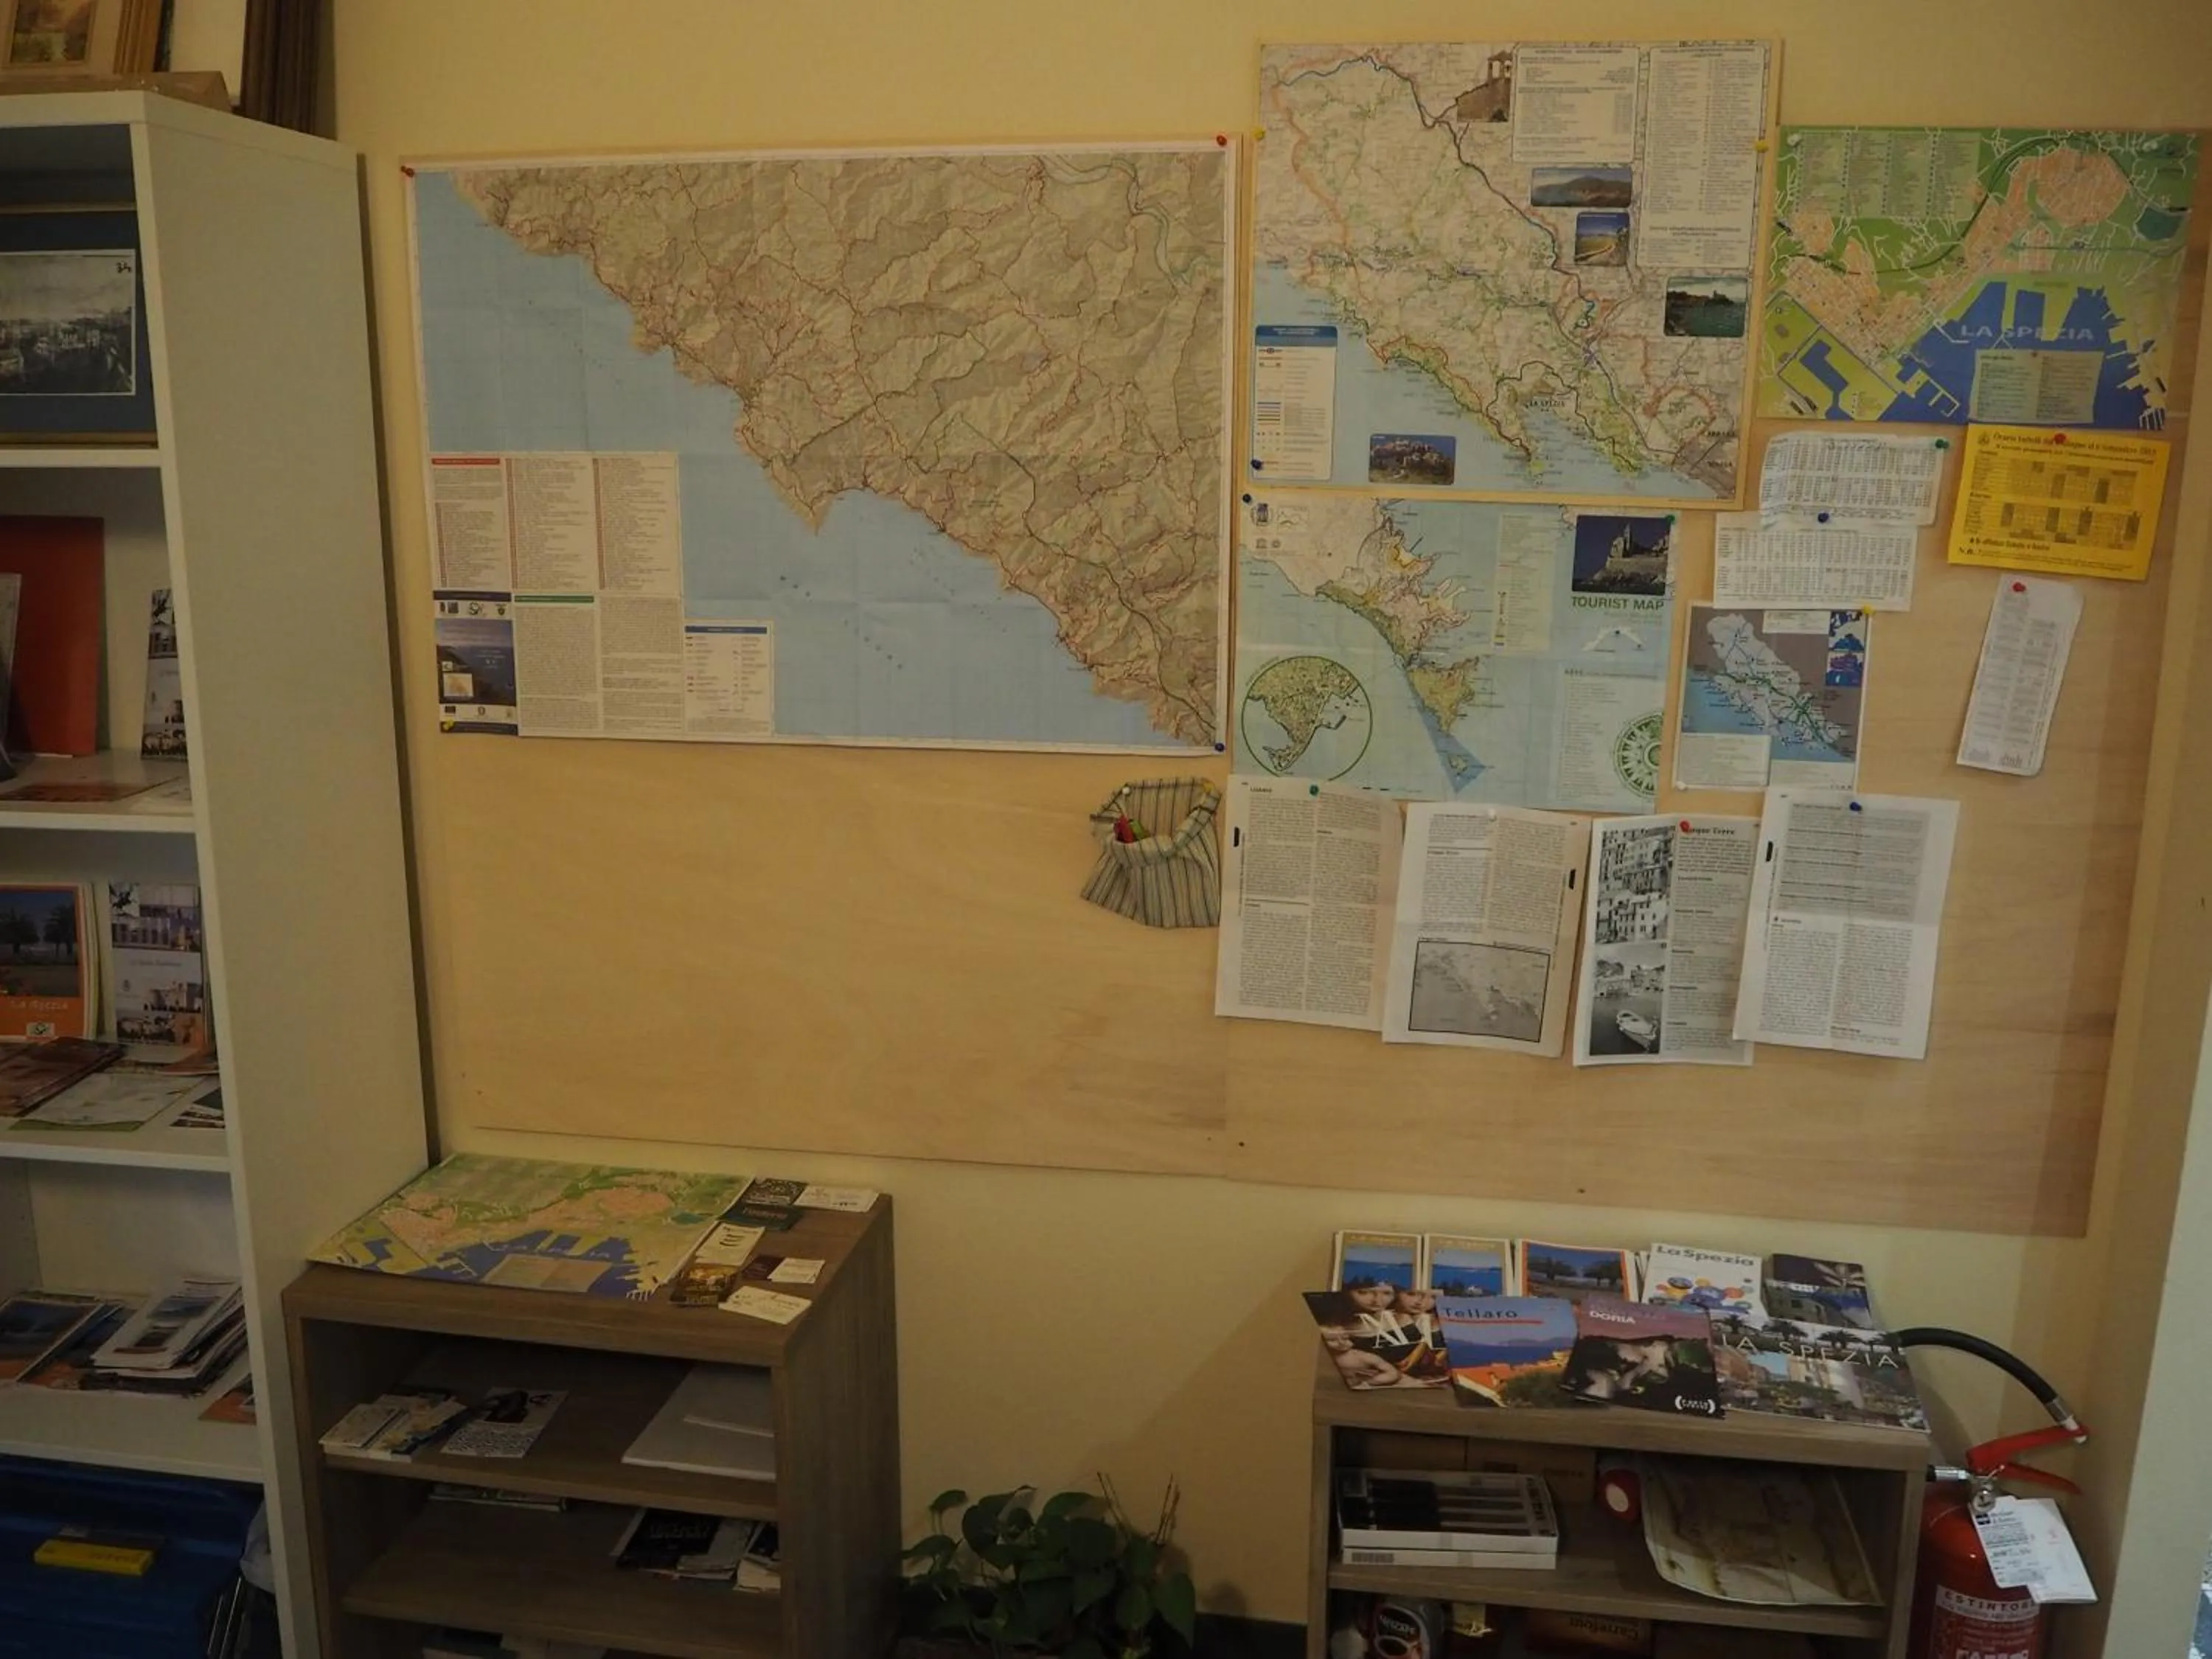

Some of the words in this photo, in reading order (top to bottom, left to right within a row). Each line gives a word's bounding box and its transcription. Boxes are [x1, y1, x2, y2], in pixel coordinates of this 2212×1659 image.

[1961, 324, 1992, 338] LA
[1572, 596, 1629, 609] TOURIST
[1633, 599, 1664, 611] MAP
[1443, 1307, 1517, 1319] Tellaro
[1722, 1332, 1759, 1354] LA
[1778, 1341, 1899, 1369] SPEZIA
